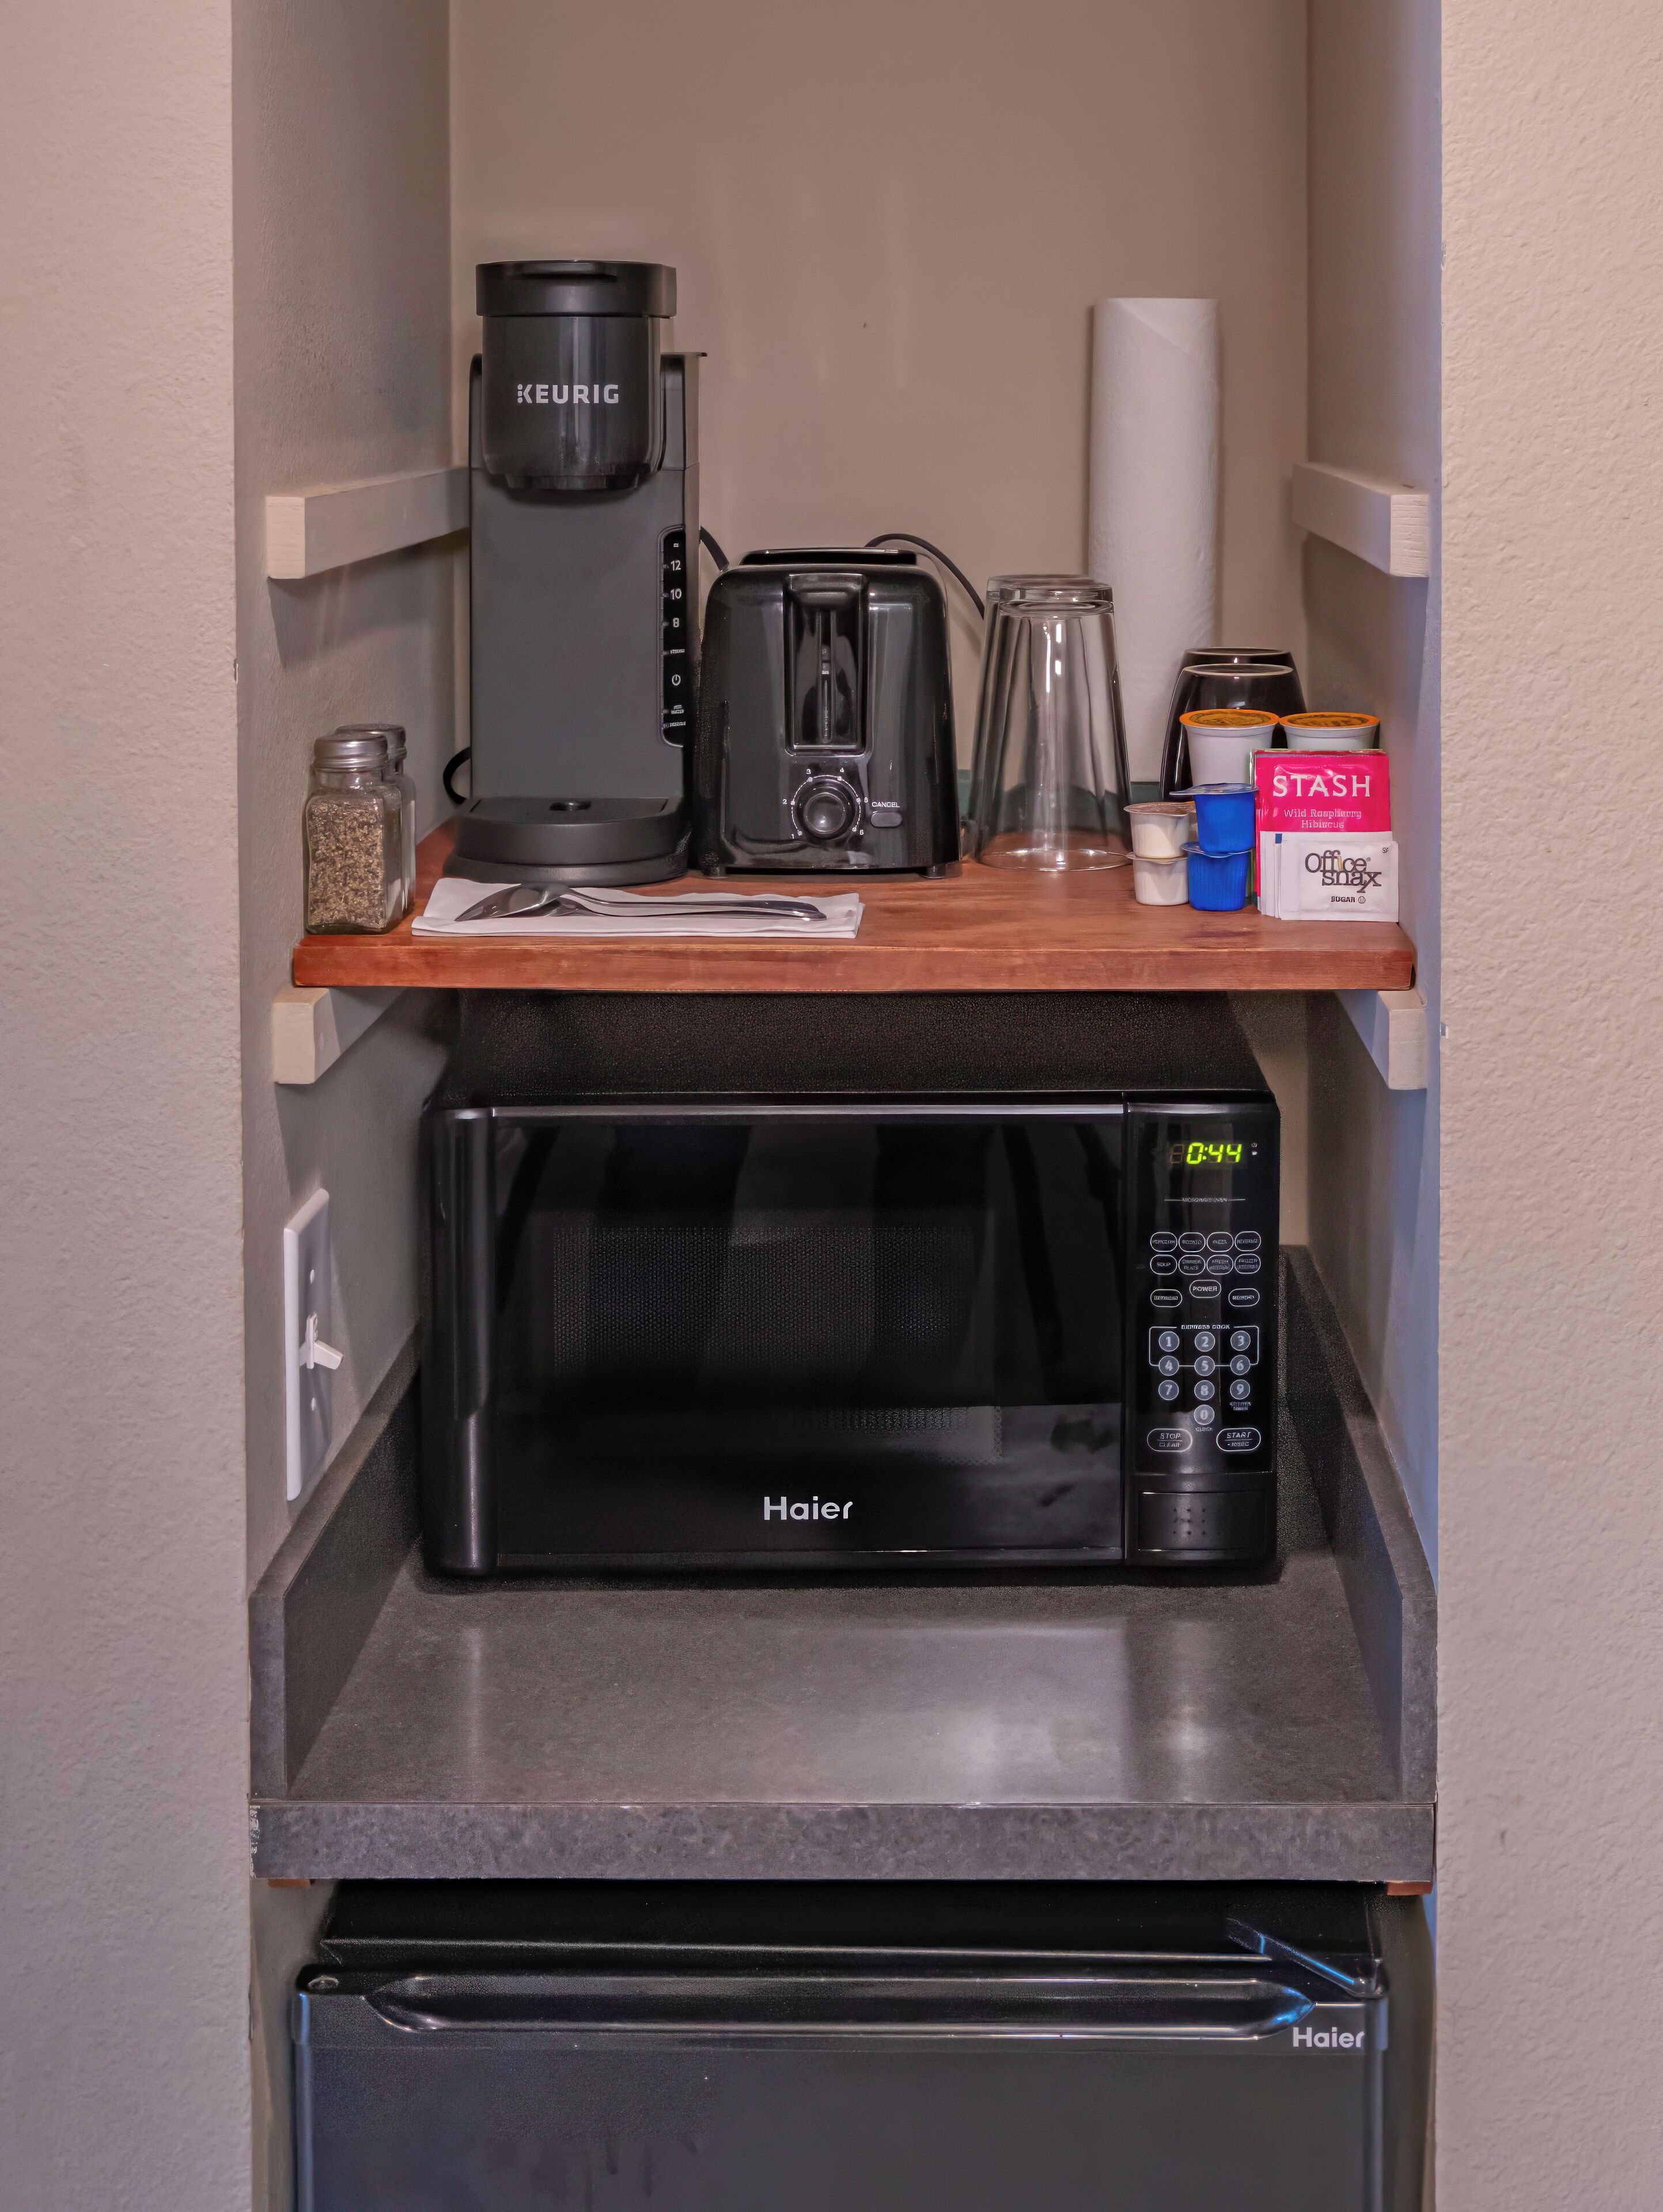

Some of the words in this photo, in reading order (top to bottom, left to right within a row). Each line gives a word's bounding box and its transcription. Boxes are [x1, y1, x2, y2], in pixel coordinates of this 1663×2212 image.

[517, 384, 619, 404] KEURIG
[670, 560, 681, 571] 12
[670, 588, 682, 600] 10
[1272, 775, 1370, 797] STASH
[1284, 809, 1306, 817] Wild
[1305, 850, 1367, 873] Office
[1322, 870, 1382, 893] snax
[1187, 1142, 1242, 1164] 0:44
[1165, 1336, 1172, 1347] 1
[1202, 1336, 1209, 1347] 2
[1237, 1335, 1244, 1346] 3
[1165, 1360, 1173, 1371] 4
[1202, 1361, 1209, 1372] 5
[1236, 1360, 1244, 1370] 6
[1165, 1385, 1173, 1395] 7
[1200, 1385, 1209, 1396] 8
[1236, 1384, 1244, 1395] 9
[1200, 1410, 1208, 1420] 0
[764, 1496, 853, 1520] Haier
[1293, 2027, 1365, 2048] Haier
